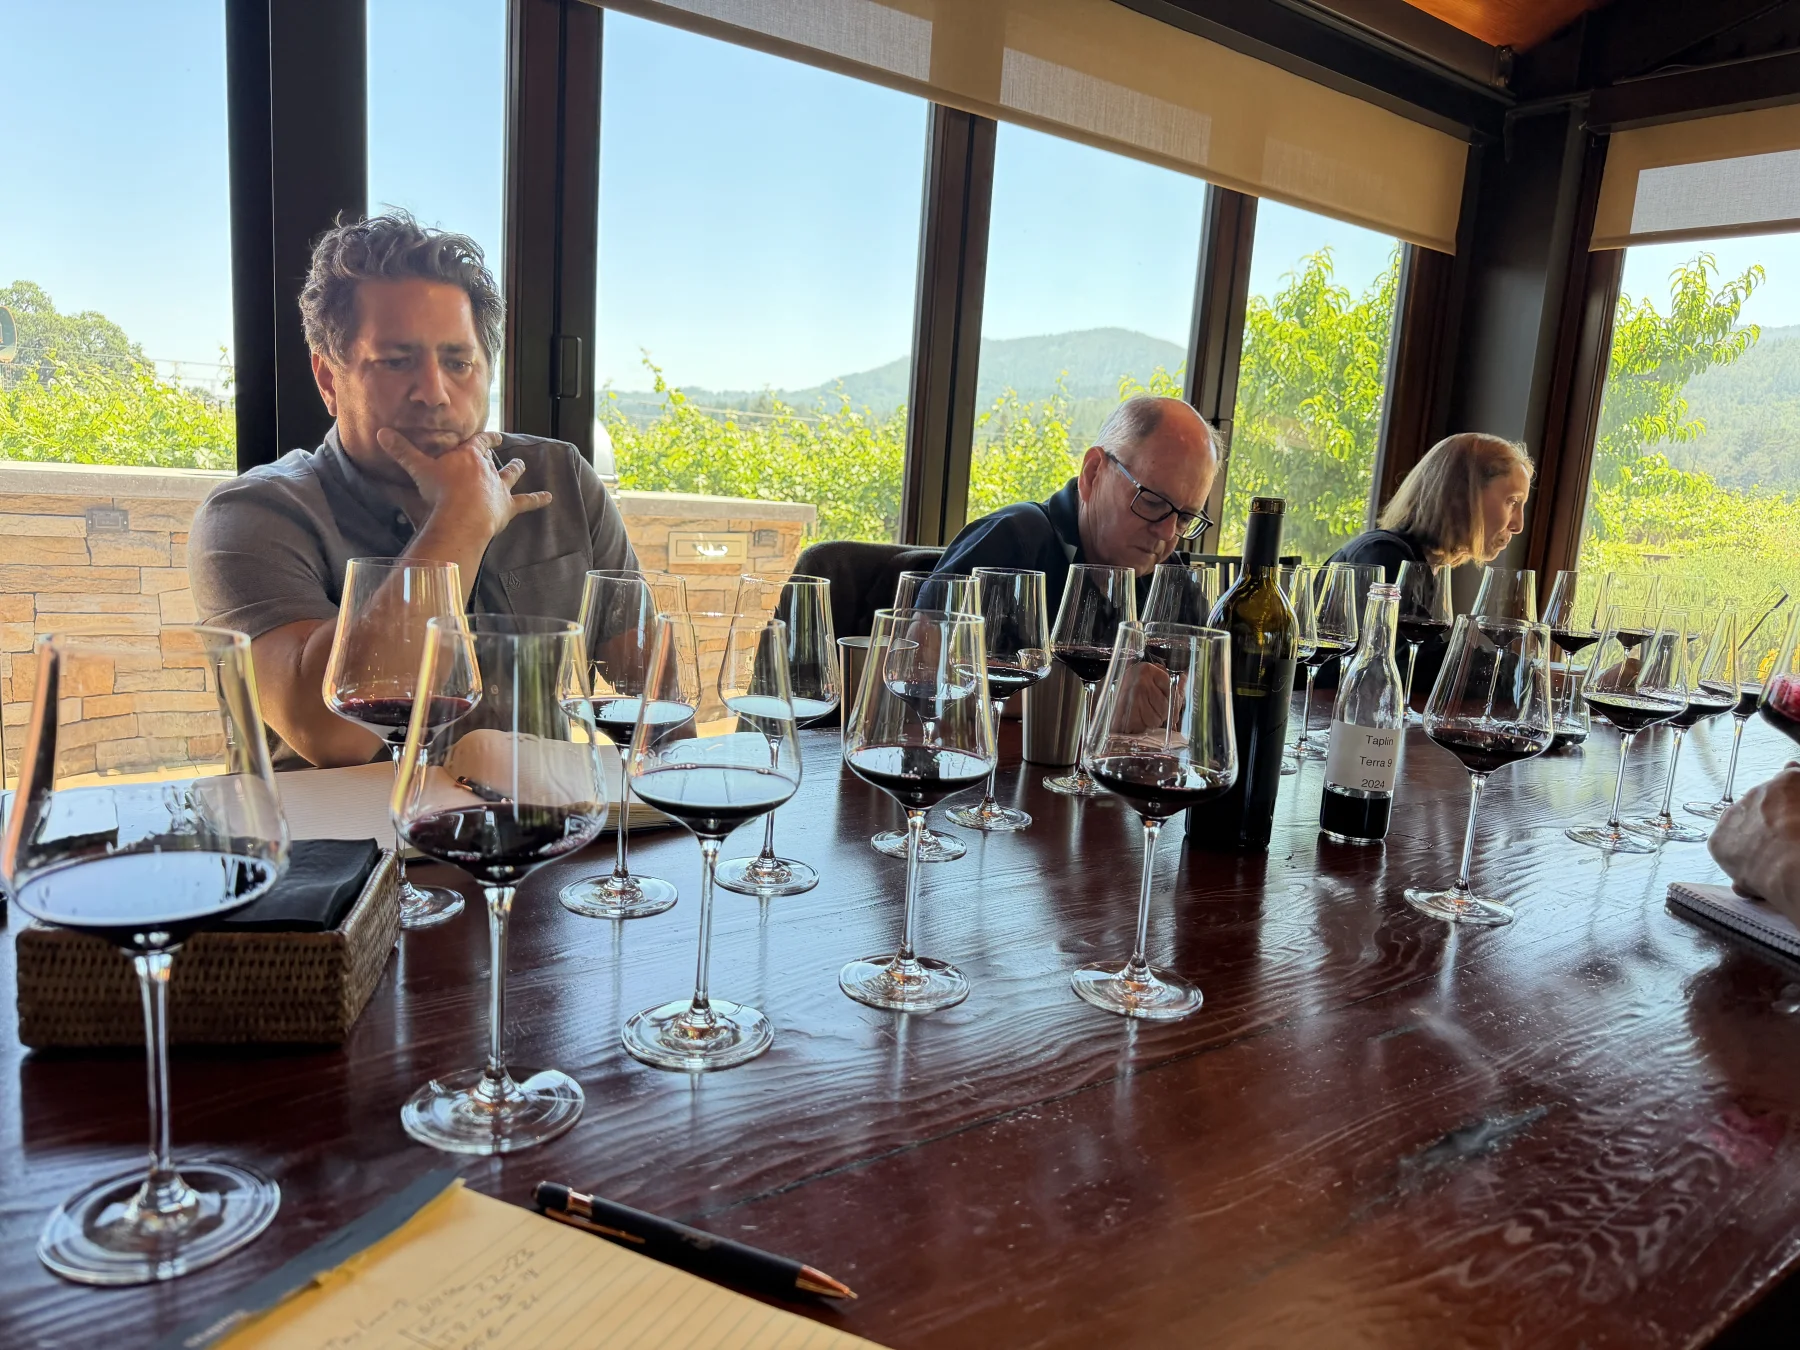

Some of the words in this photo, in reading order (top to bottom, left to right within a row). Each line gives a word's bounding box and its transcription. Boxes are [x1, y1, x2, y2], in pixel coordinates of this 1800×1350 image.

[1365, 735, 1394, 746] Taplin
[1359, 755, 1385, 768] Terra
[1387, 758, 1393, 768] 9
[1361, 779, 1385, 789] 2024
